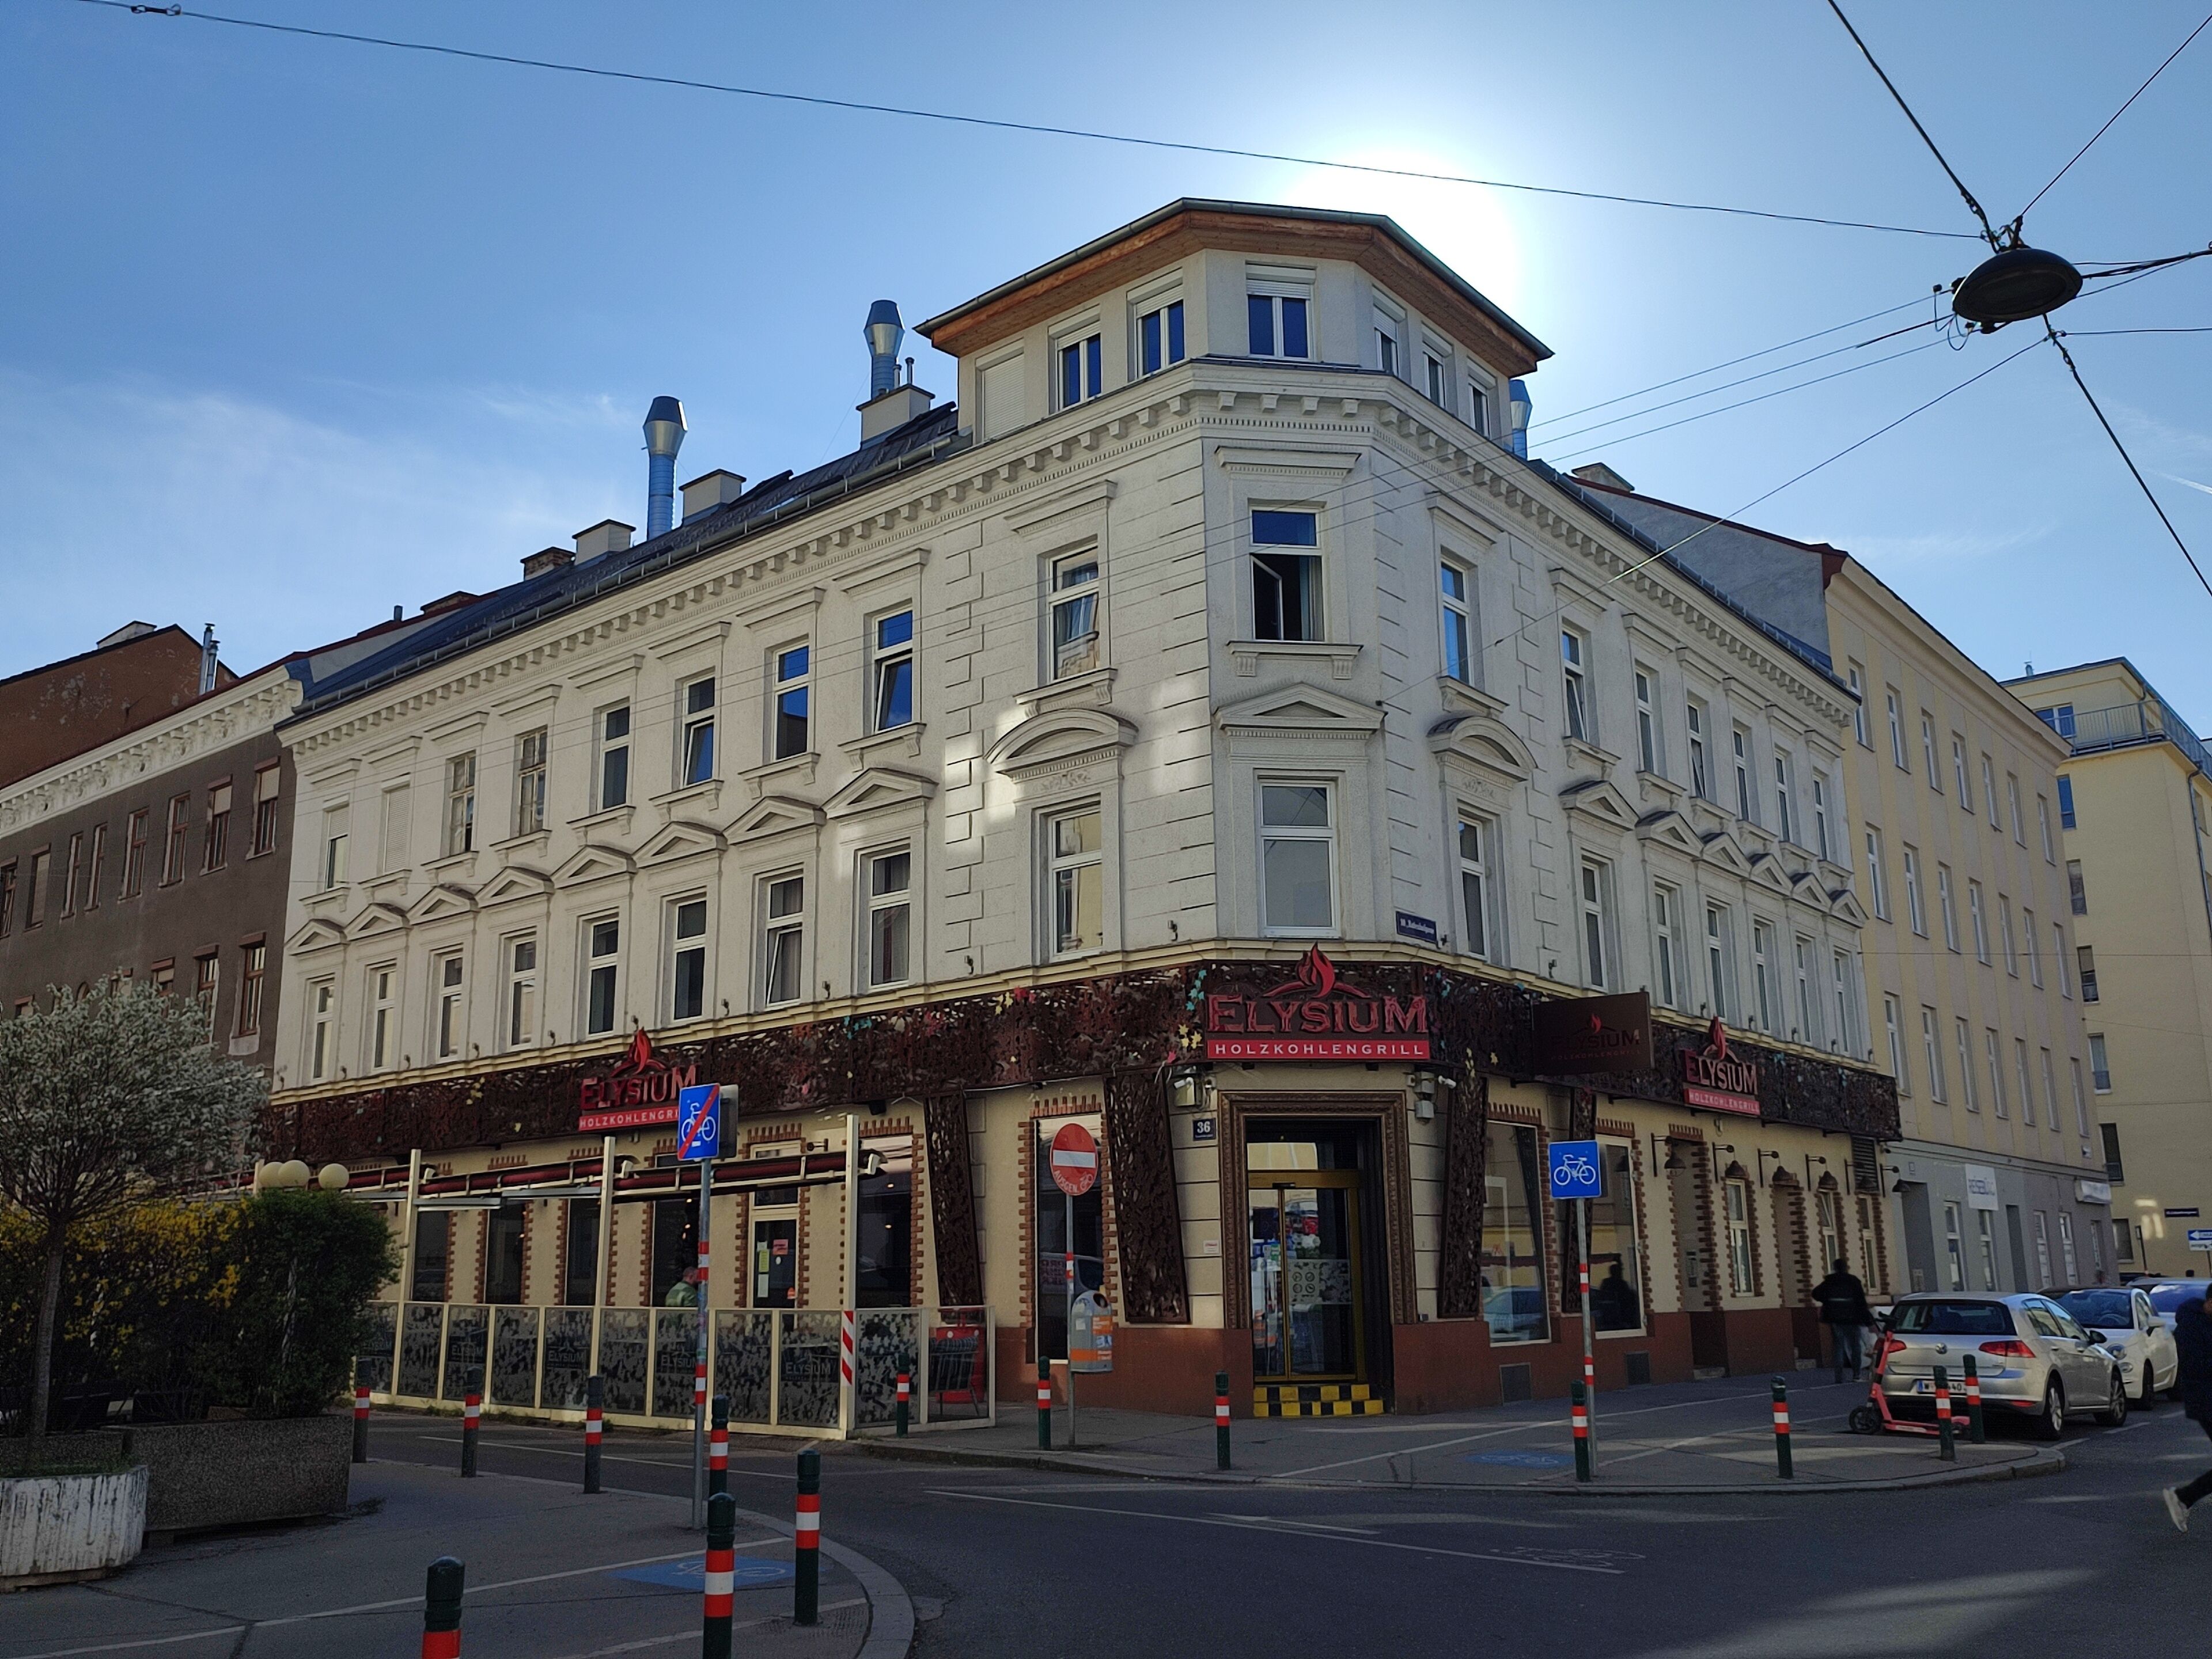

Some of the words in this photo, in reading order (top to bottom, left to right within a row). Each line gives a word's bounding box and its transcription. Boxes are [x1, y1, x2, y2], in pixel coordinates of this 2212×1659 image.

[1206, 993, 1429, 1034] ELYSIUM
[1214, 1042, 1424, 1056] HOLZKOHLENGRILL
[1684, 1050, 1759, 1095] ELYSIUM
[581, 1063, 699, 1110] ELYSIUM
[1688, 1091, 1760, 1112] HOLZKOHLENGRILL
[579, 1109, 679, 1128] HOLZKOHLENGRI
[1196, 1120, 1211, 1134] 36
[785, 1361, 831, 1376] ELYSIUM
